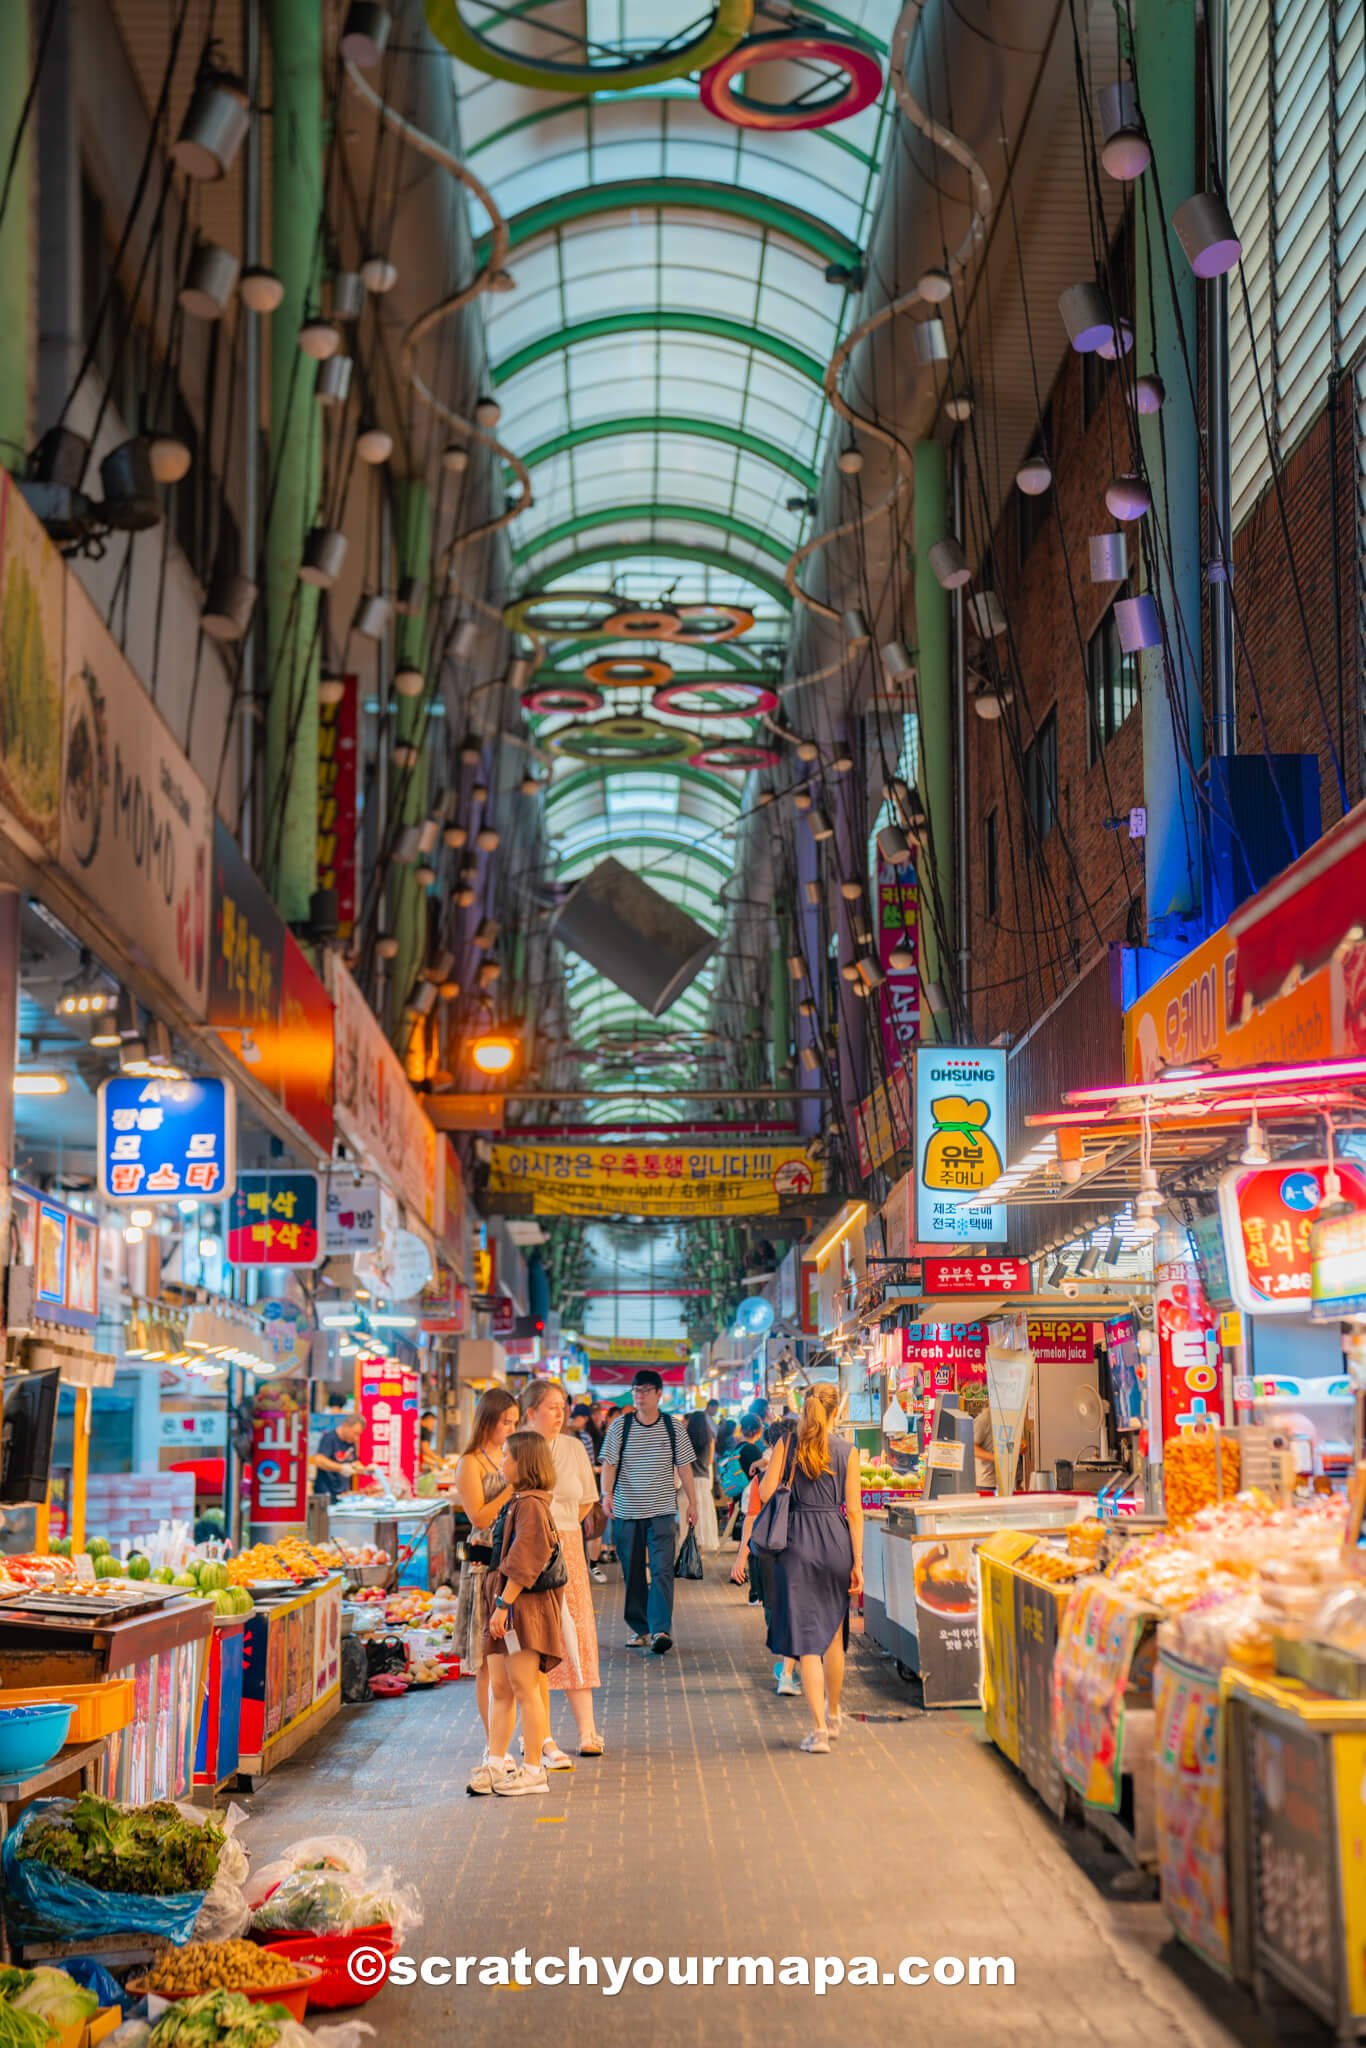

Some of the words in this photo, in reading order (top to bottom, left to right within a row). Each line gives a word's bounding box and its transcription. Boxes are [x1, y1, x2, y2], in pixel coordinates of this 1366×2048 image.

[112, 742, 176, 906] MOMO
[931, 1069, 995, 1082] OHSUNG
[508, 1153, 592, 1179] 야시장은
[600, 1153, 683, 1180] 우측통행
[940, 1146, 984, 1169] 유부
[940, 1171, 984, 1186] 주머니
[629, 1184, 663, 1198] right
[247, 1191, 298, 1219] 빠삭
[932, 1218, 956, 1231] 전국
[969, 1217, 993, 1230] 택배
[252, 1223, 301, 1250] 빠삭
[938, 1267, 974, 1283] 유부속
[977, 1262, 1017, 1290] 우동
[907, 1346, 943, 1358] Fresh
[947, 1346, 981, 1358] Juice
[1068, 1346, 1087, 1361] juice
